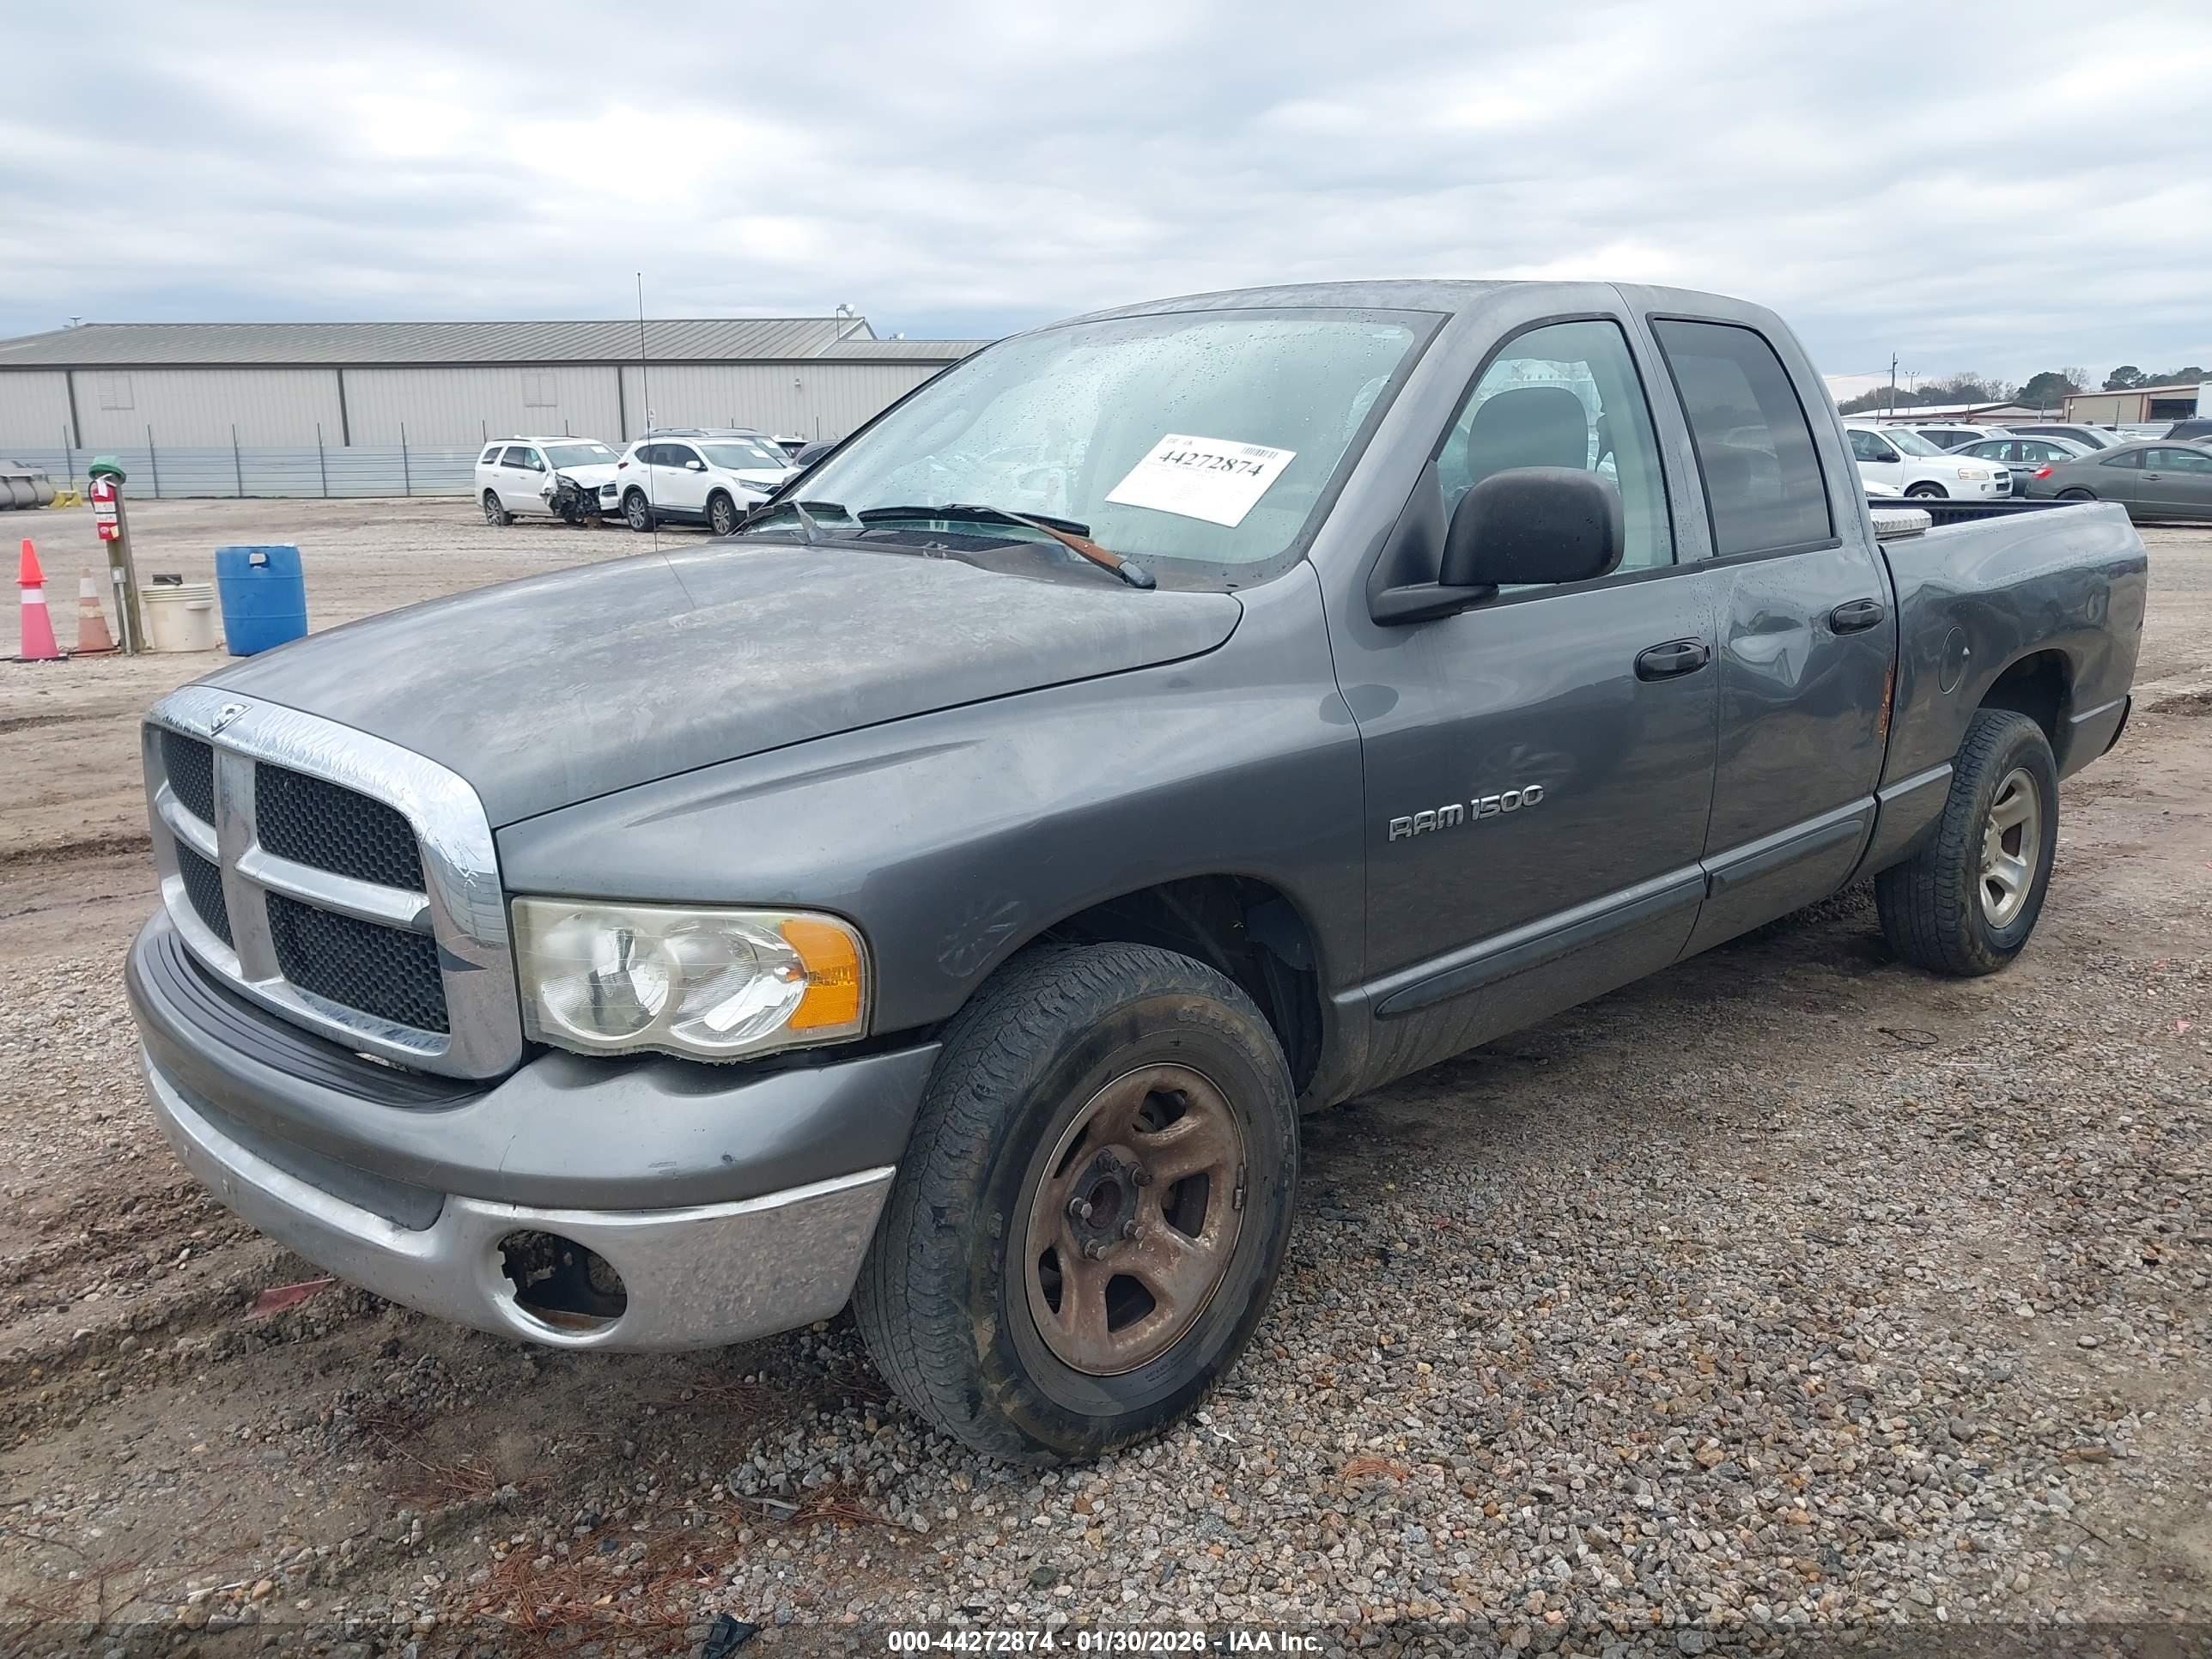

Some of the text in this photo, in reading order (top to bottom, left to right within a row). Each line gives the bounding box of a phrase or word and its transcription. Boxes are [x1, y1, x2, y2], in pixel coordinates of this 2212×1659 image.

[1159, 450, 1265, 477] 44272874
[1389, 784, 1544, 842] RAM 1500
